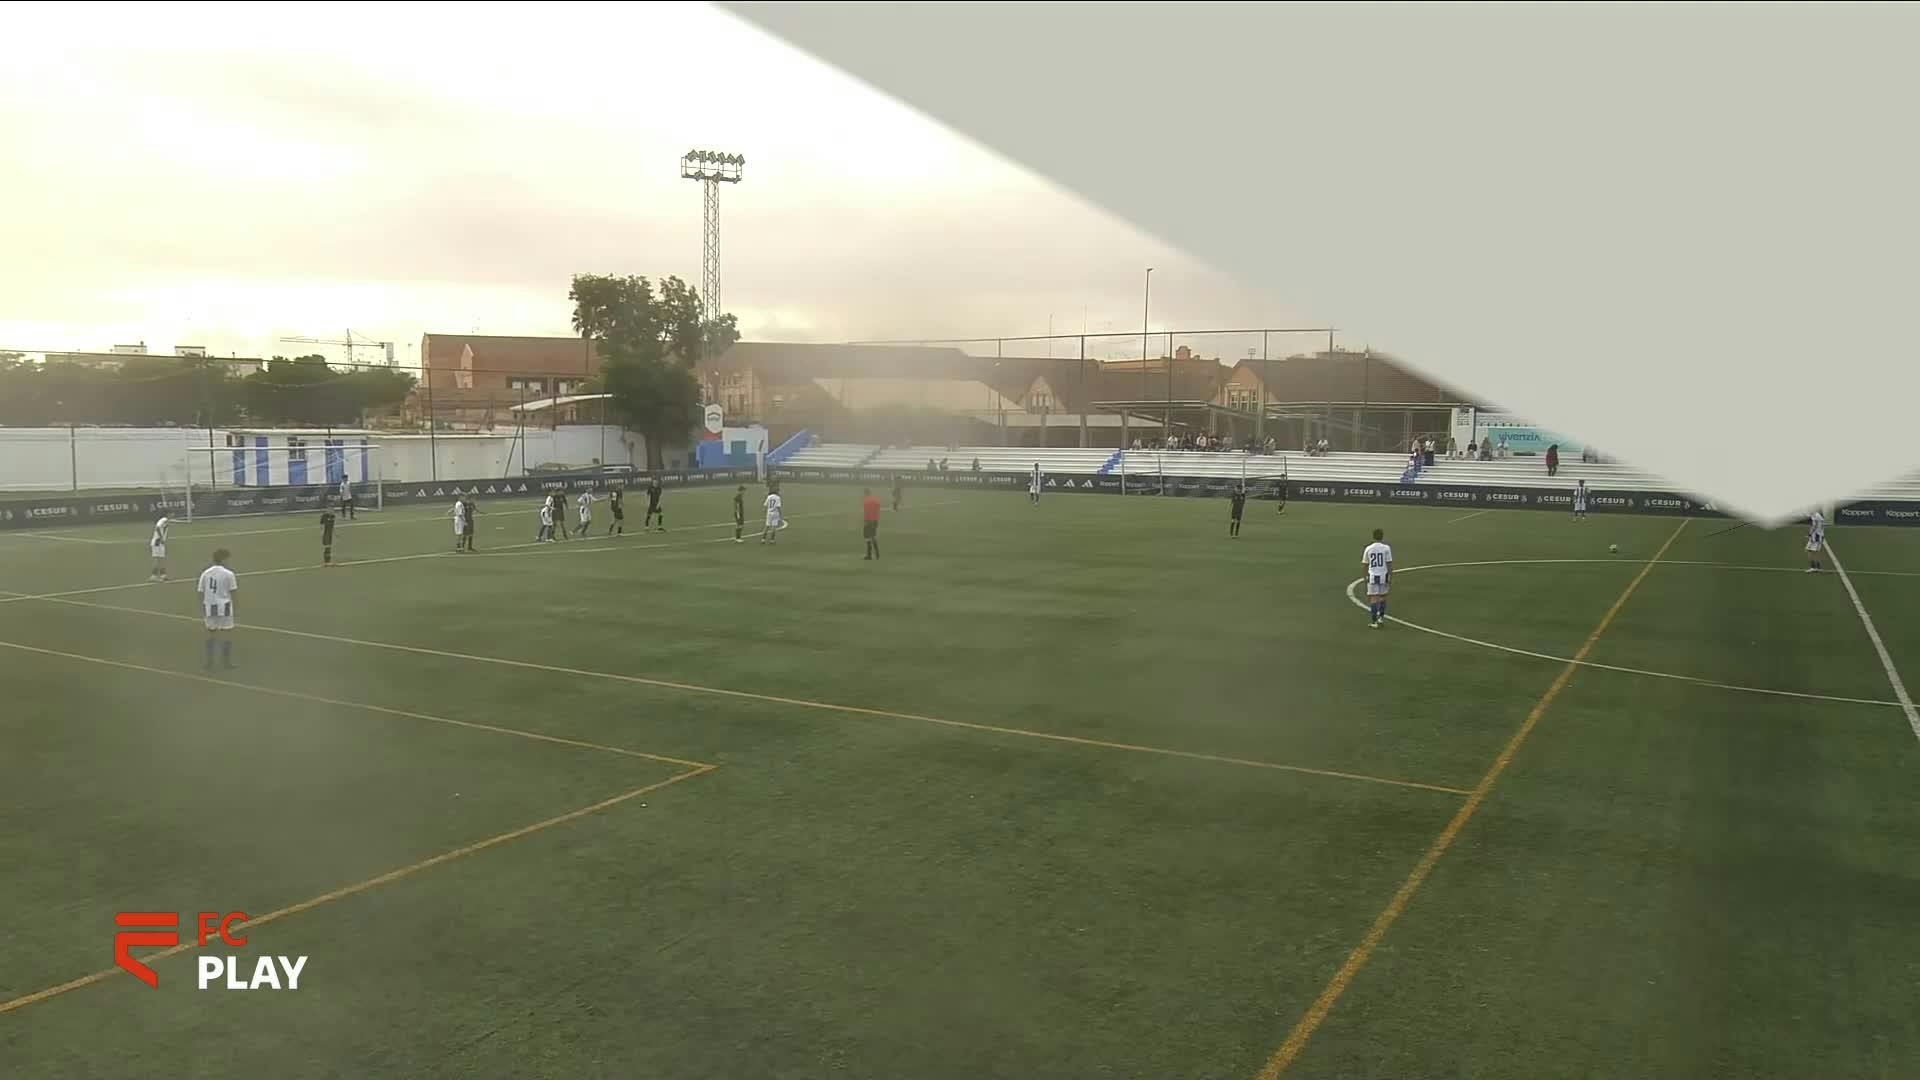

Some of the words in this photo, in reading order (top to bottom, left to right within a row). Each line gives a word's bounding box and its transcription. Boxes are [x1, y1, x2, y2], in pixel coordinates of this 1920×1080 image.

[33, 506, 67, 516] CESUR
[96, 503, 129, 512] CESUR
[1841, 509, 1874, 517] Koppert
[1886, 510, 1920, 518] Koppert
[1370, 552, 1384, 568] 20
[209, 576, 217, 594] 4
